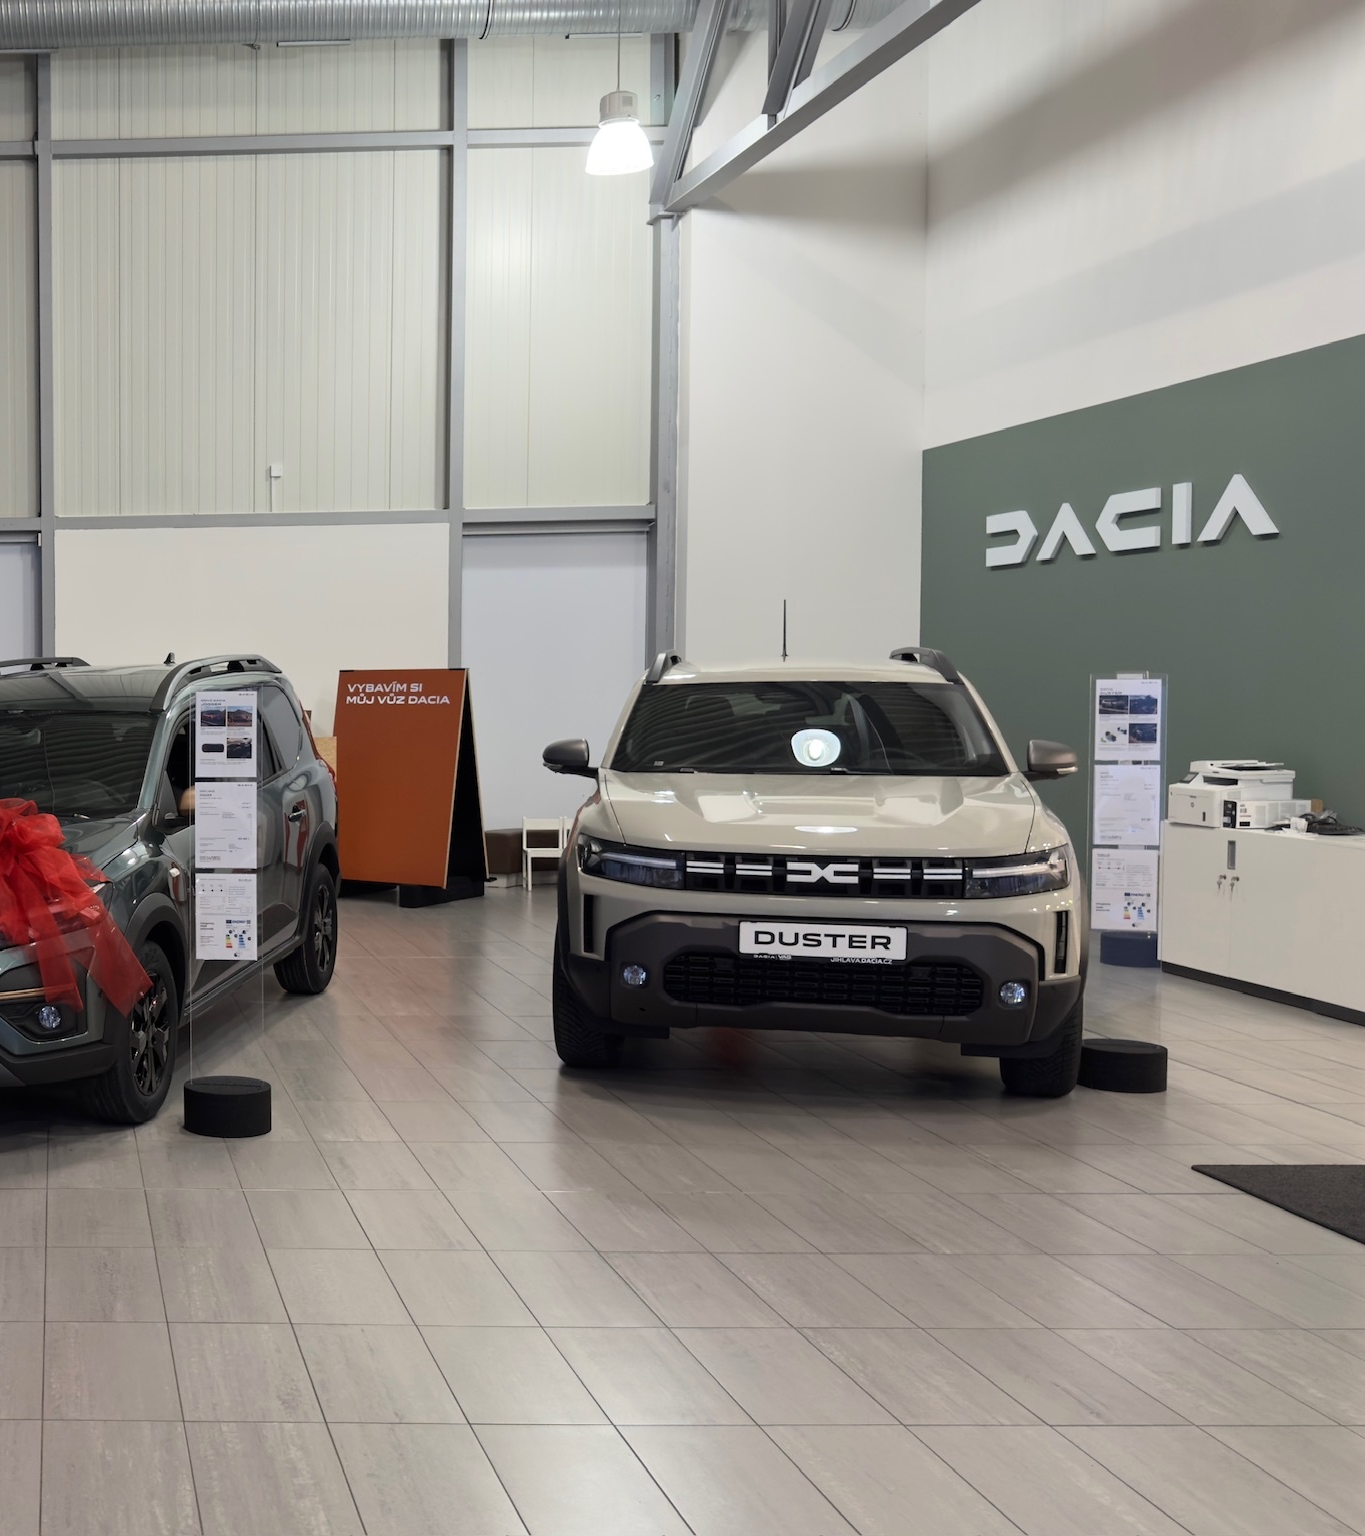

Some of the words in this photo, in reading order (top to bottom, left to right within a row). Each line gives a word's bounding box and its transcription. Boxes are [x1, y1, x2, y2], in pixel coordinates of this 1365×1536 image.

[985, 473, 1280, 568] DACIA
[347, 680, 407, 693] VYBAVÍM
[410, 683, 423, 693] SI
[346, 693, 374, 704] MŮJ
[377, 693, 405, 704] VŮZ
[408, 696, 450, 705] DACIA
[753, 930, 892, 951] DUSTER
